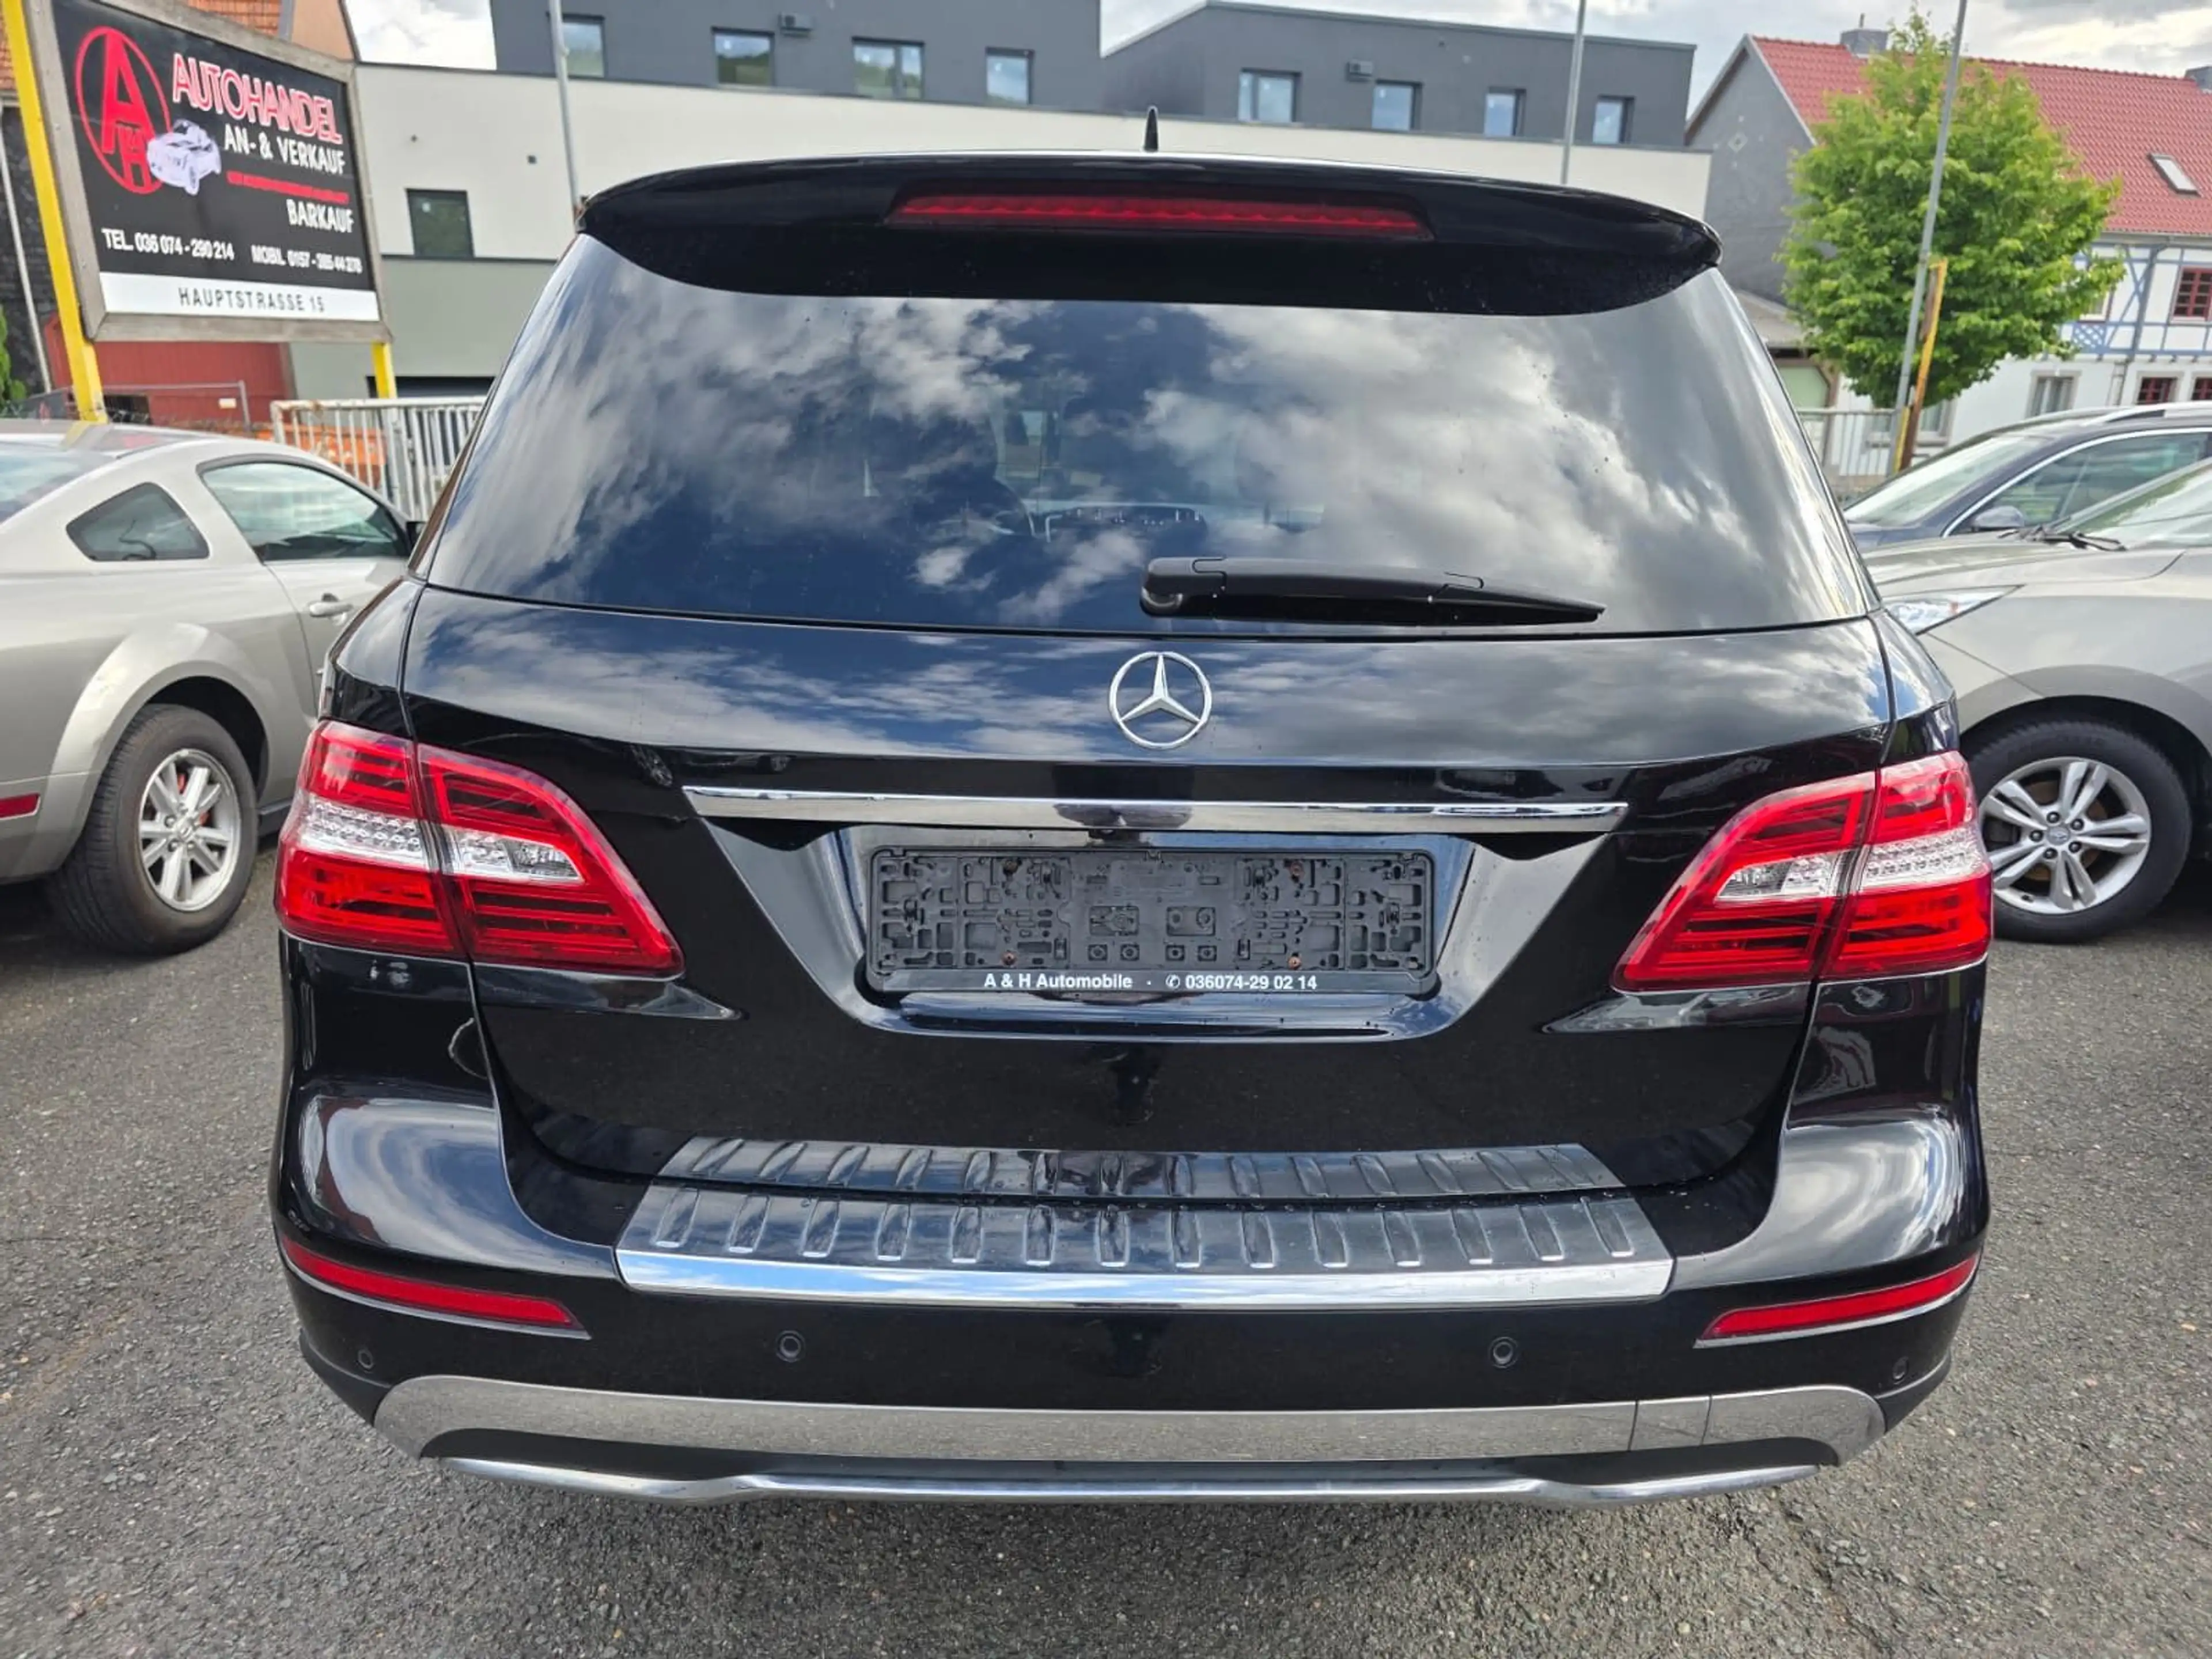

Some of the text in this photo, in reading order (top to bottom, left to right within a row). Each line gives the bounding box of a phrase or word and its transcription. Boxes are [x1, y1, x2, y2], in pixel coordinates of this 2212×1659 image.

[173, 52, 343, 144] AUTOHANDEL
[224, 123, 346, 174] AN- & VERKAUF
[286, 198, 354, 233] BARKAUF
[213, 240, 235, 261] 214
[178, 286, 305, 312] HAUPTSTRASSE
[984, 973, 1318, 990] A & H Automobile 036074-29 02 14
